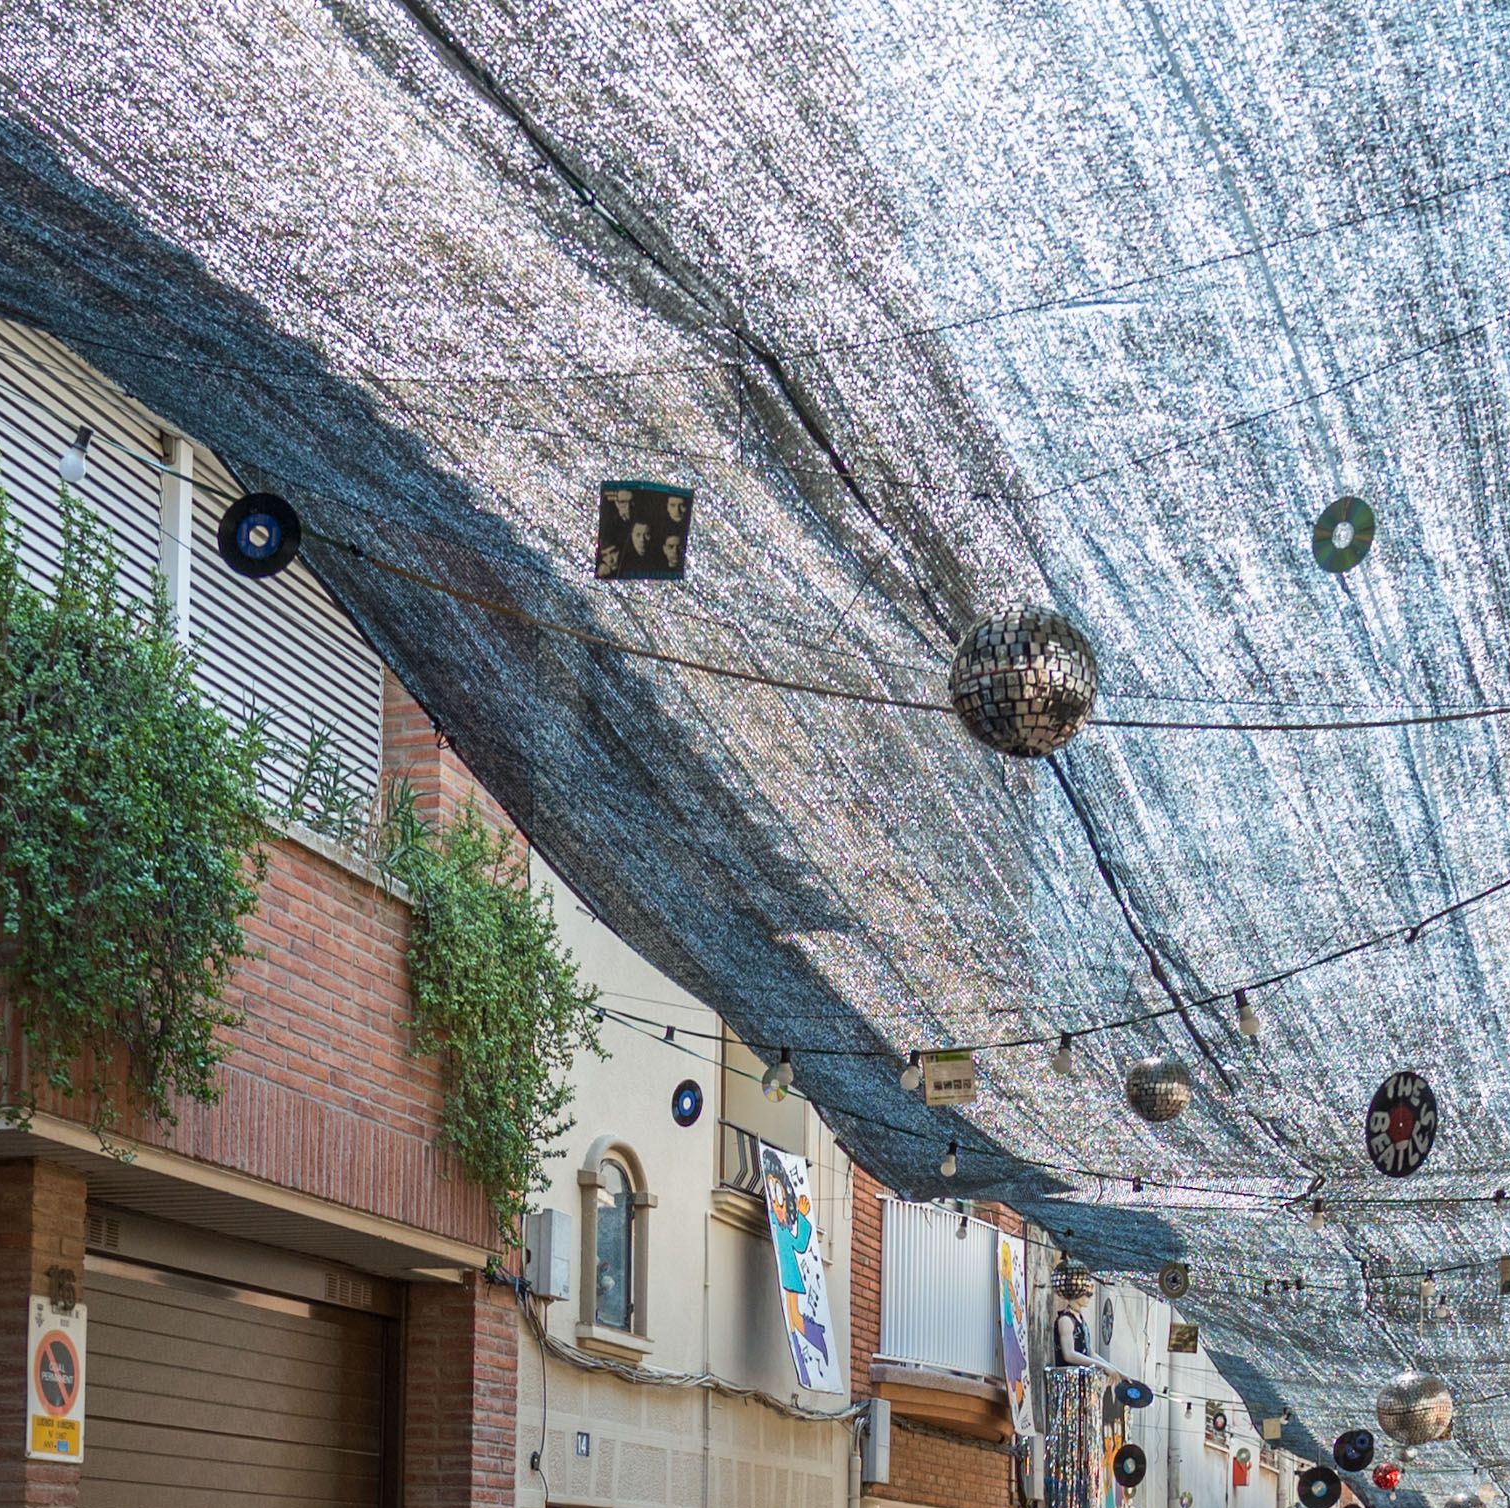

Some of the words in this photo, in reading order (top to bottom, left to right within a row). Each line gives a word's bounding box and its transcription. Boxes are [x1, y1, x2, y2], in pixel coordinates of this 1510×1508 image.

[1385, 1075, 1426, 1107] THE
[1370, 1102, 1435, 1172] BEATLES
[44, 1264, 76, 1311] 16
[577, 1433, 587, 1454] 14
